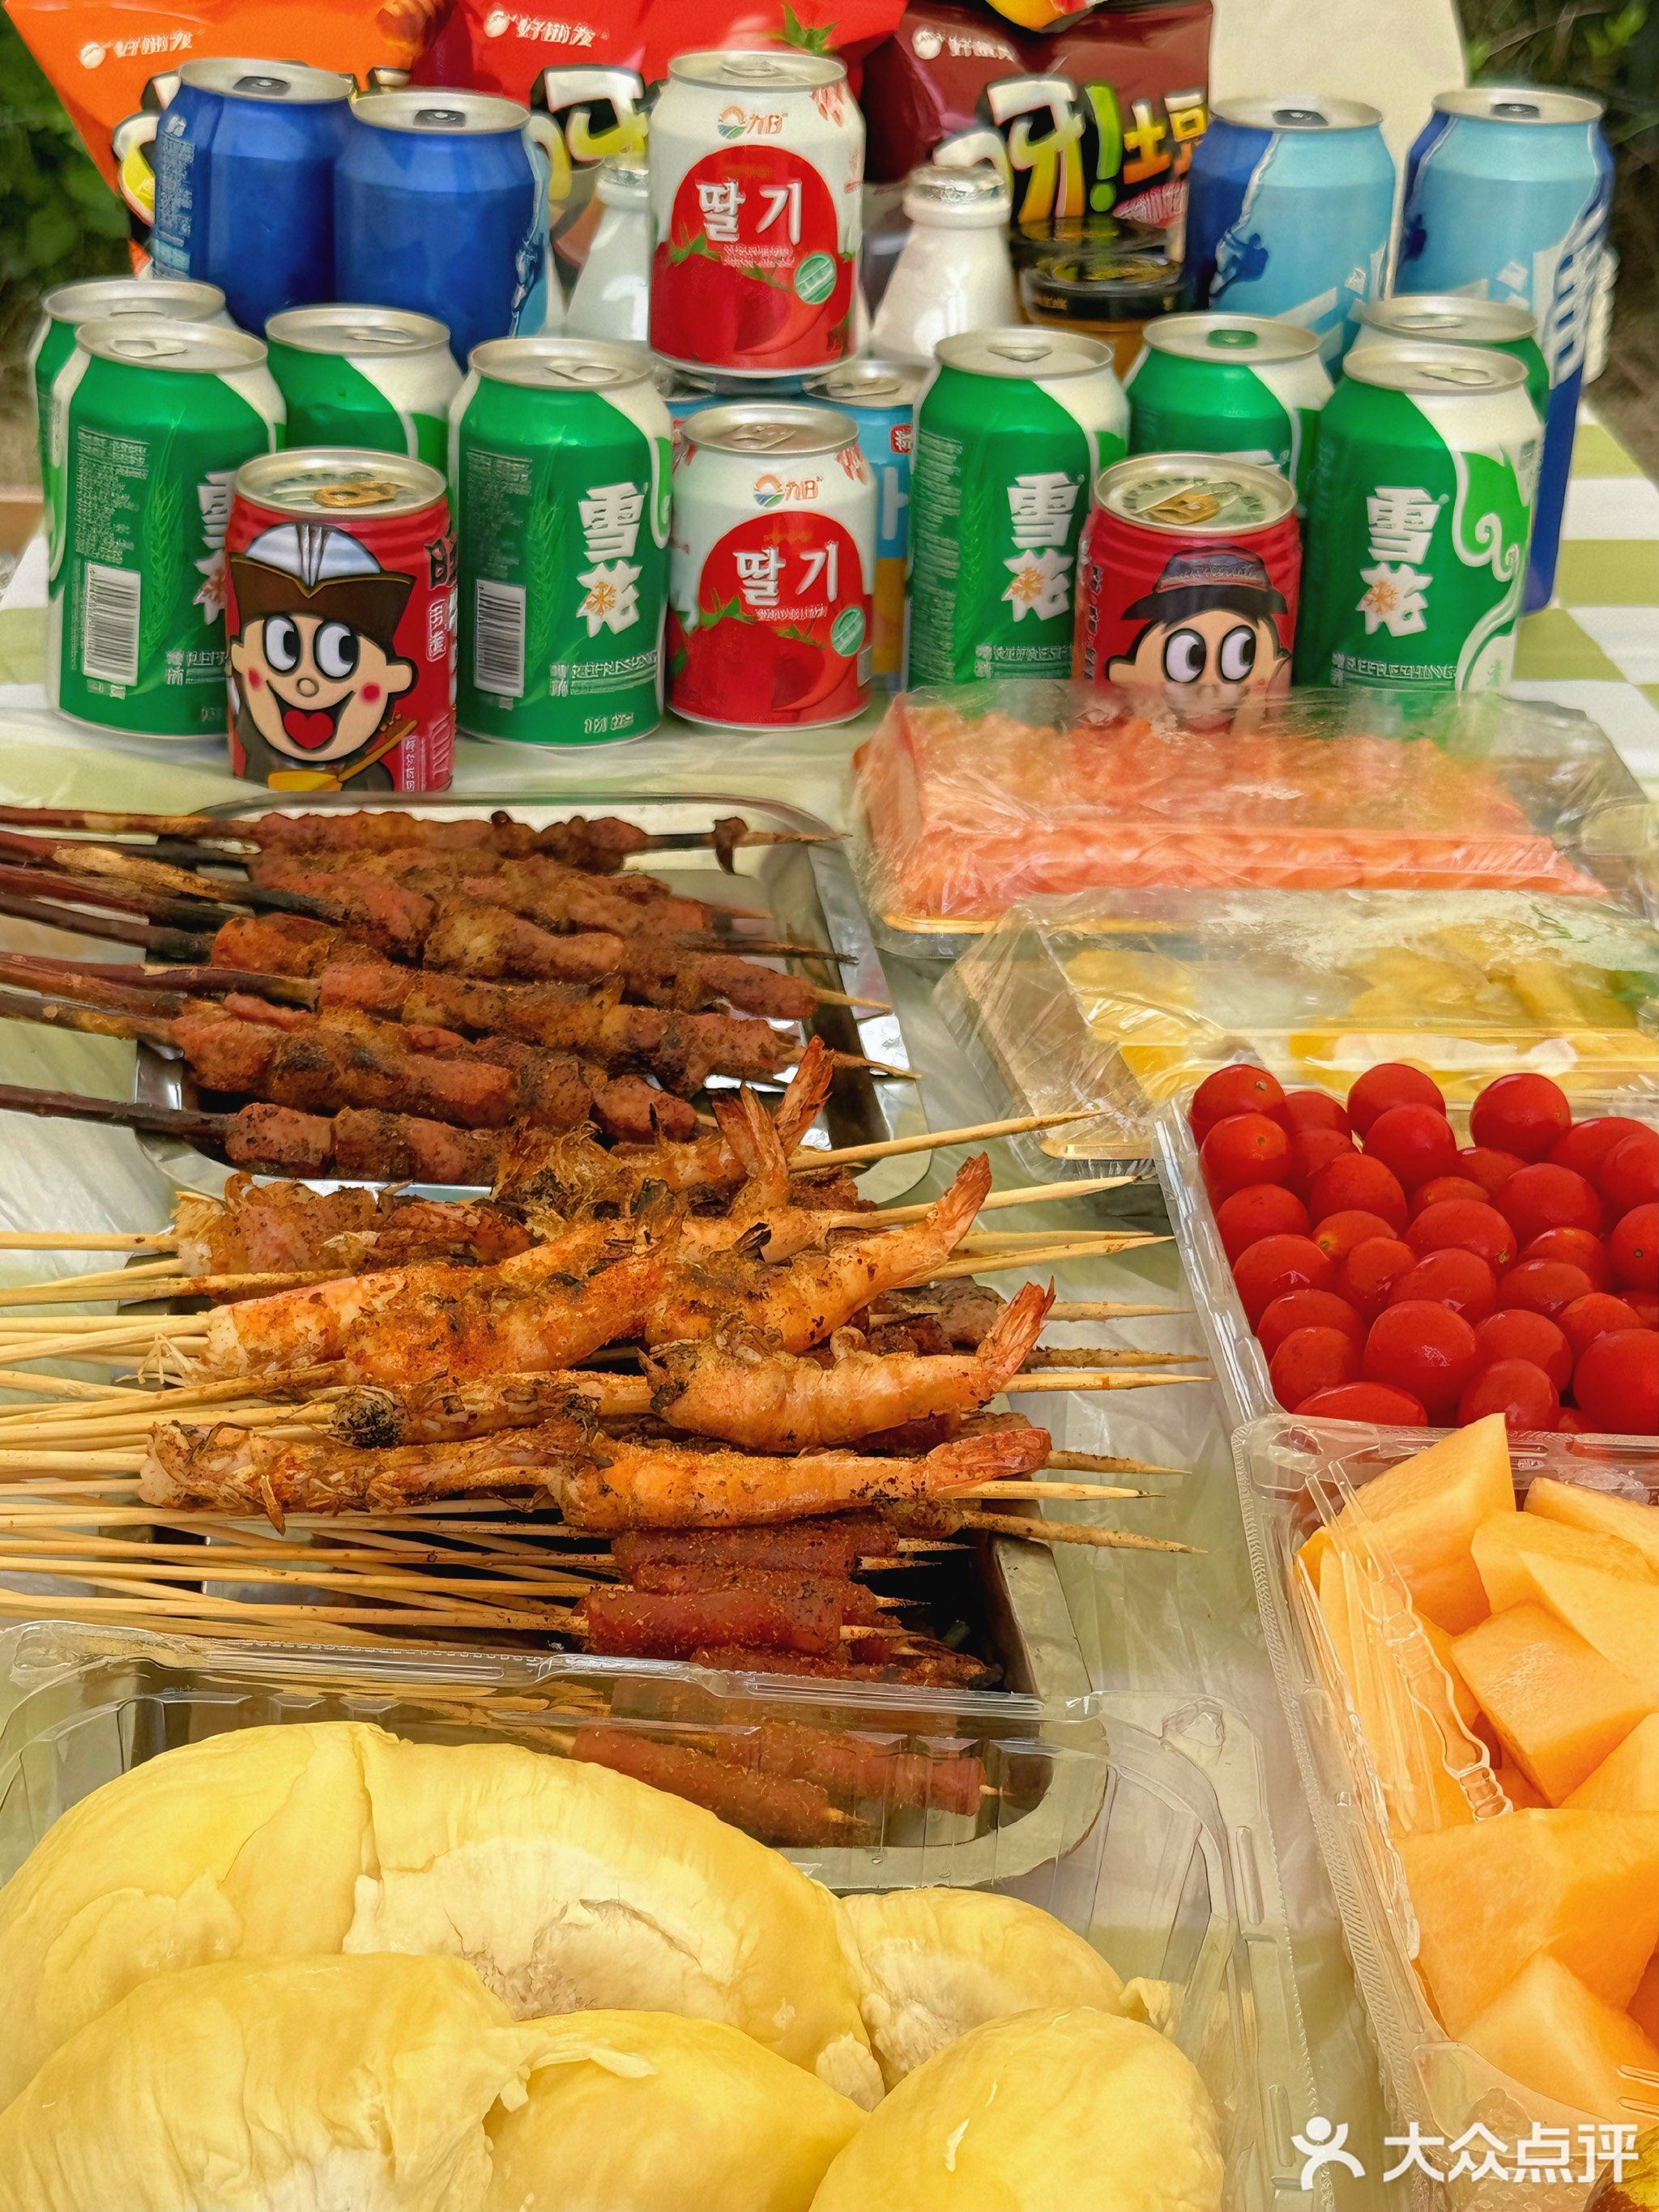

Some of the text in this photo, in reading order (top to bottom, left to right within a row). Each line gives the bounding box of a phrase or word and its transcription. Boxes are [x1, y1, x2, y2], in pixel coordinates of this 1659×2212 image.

[576, 482, 646, 638] 雪花
[1001, 471, 1079, 622] 雪花
[1355, 486, 1440, 637] 雪花
